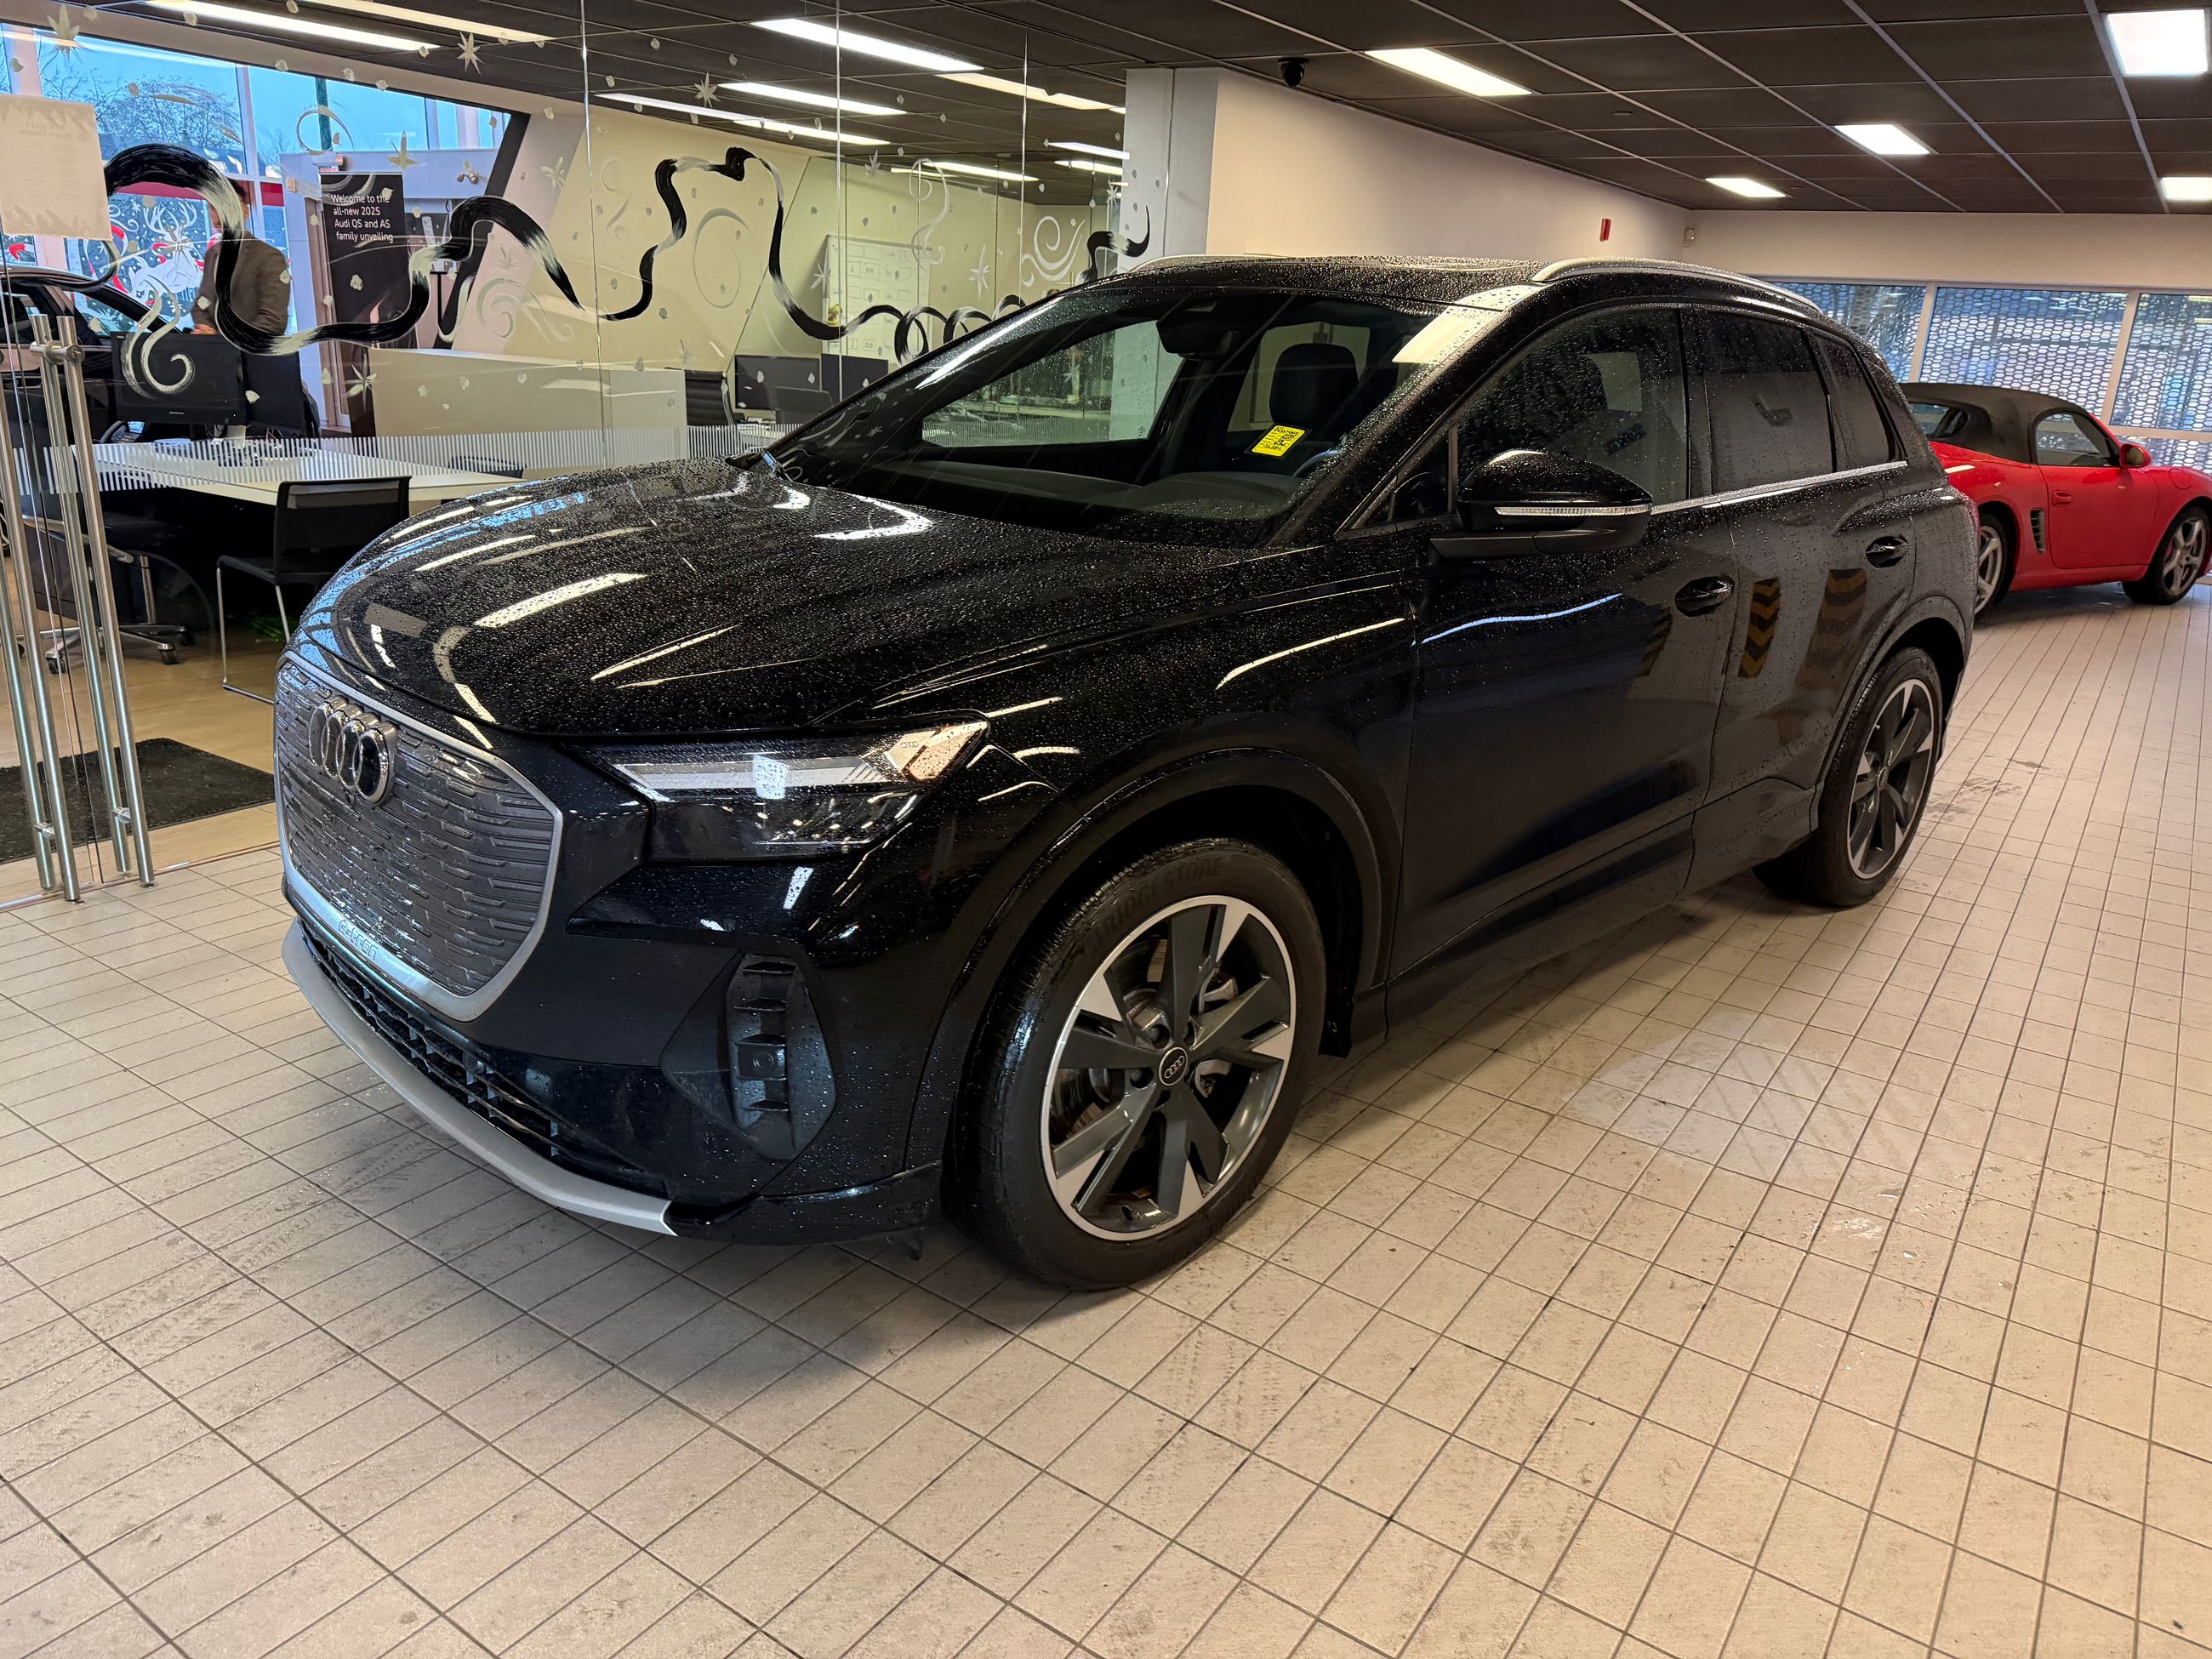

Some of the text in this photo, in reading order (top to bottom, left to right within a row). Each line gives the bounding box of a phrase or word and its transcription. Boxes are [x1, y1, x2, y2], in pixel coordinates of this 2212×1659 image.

[331, 194, 365, 203] Welcome
[366, 195, 374, 203] to
[333, 206, 381, 216] all-new 2025
[334, 219, 351, 228] Audi
[364, 219, 379, 229] and
[336, 231, 394, 243] family unveiling
